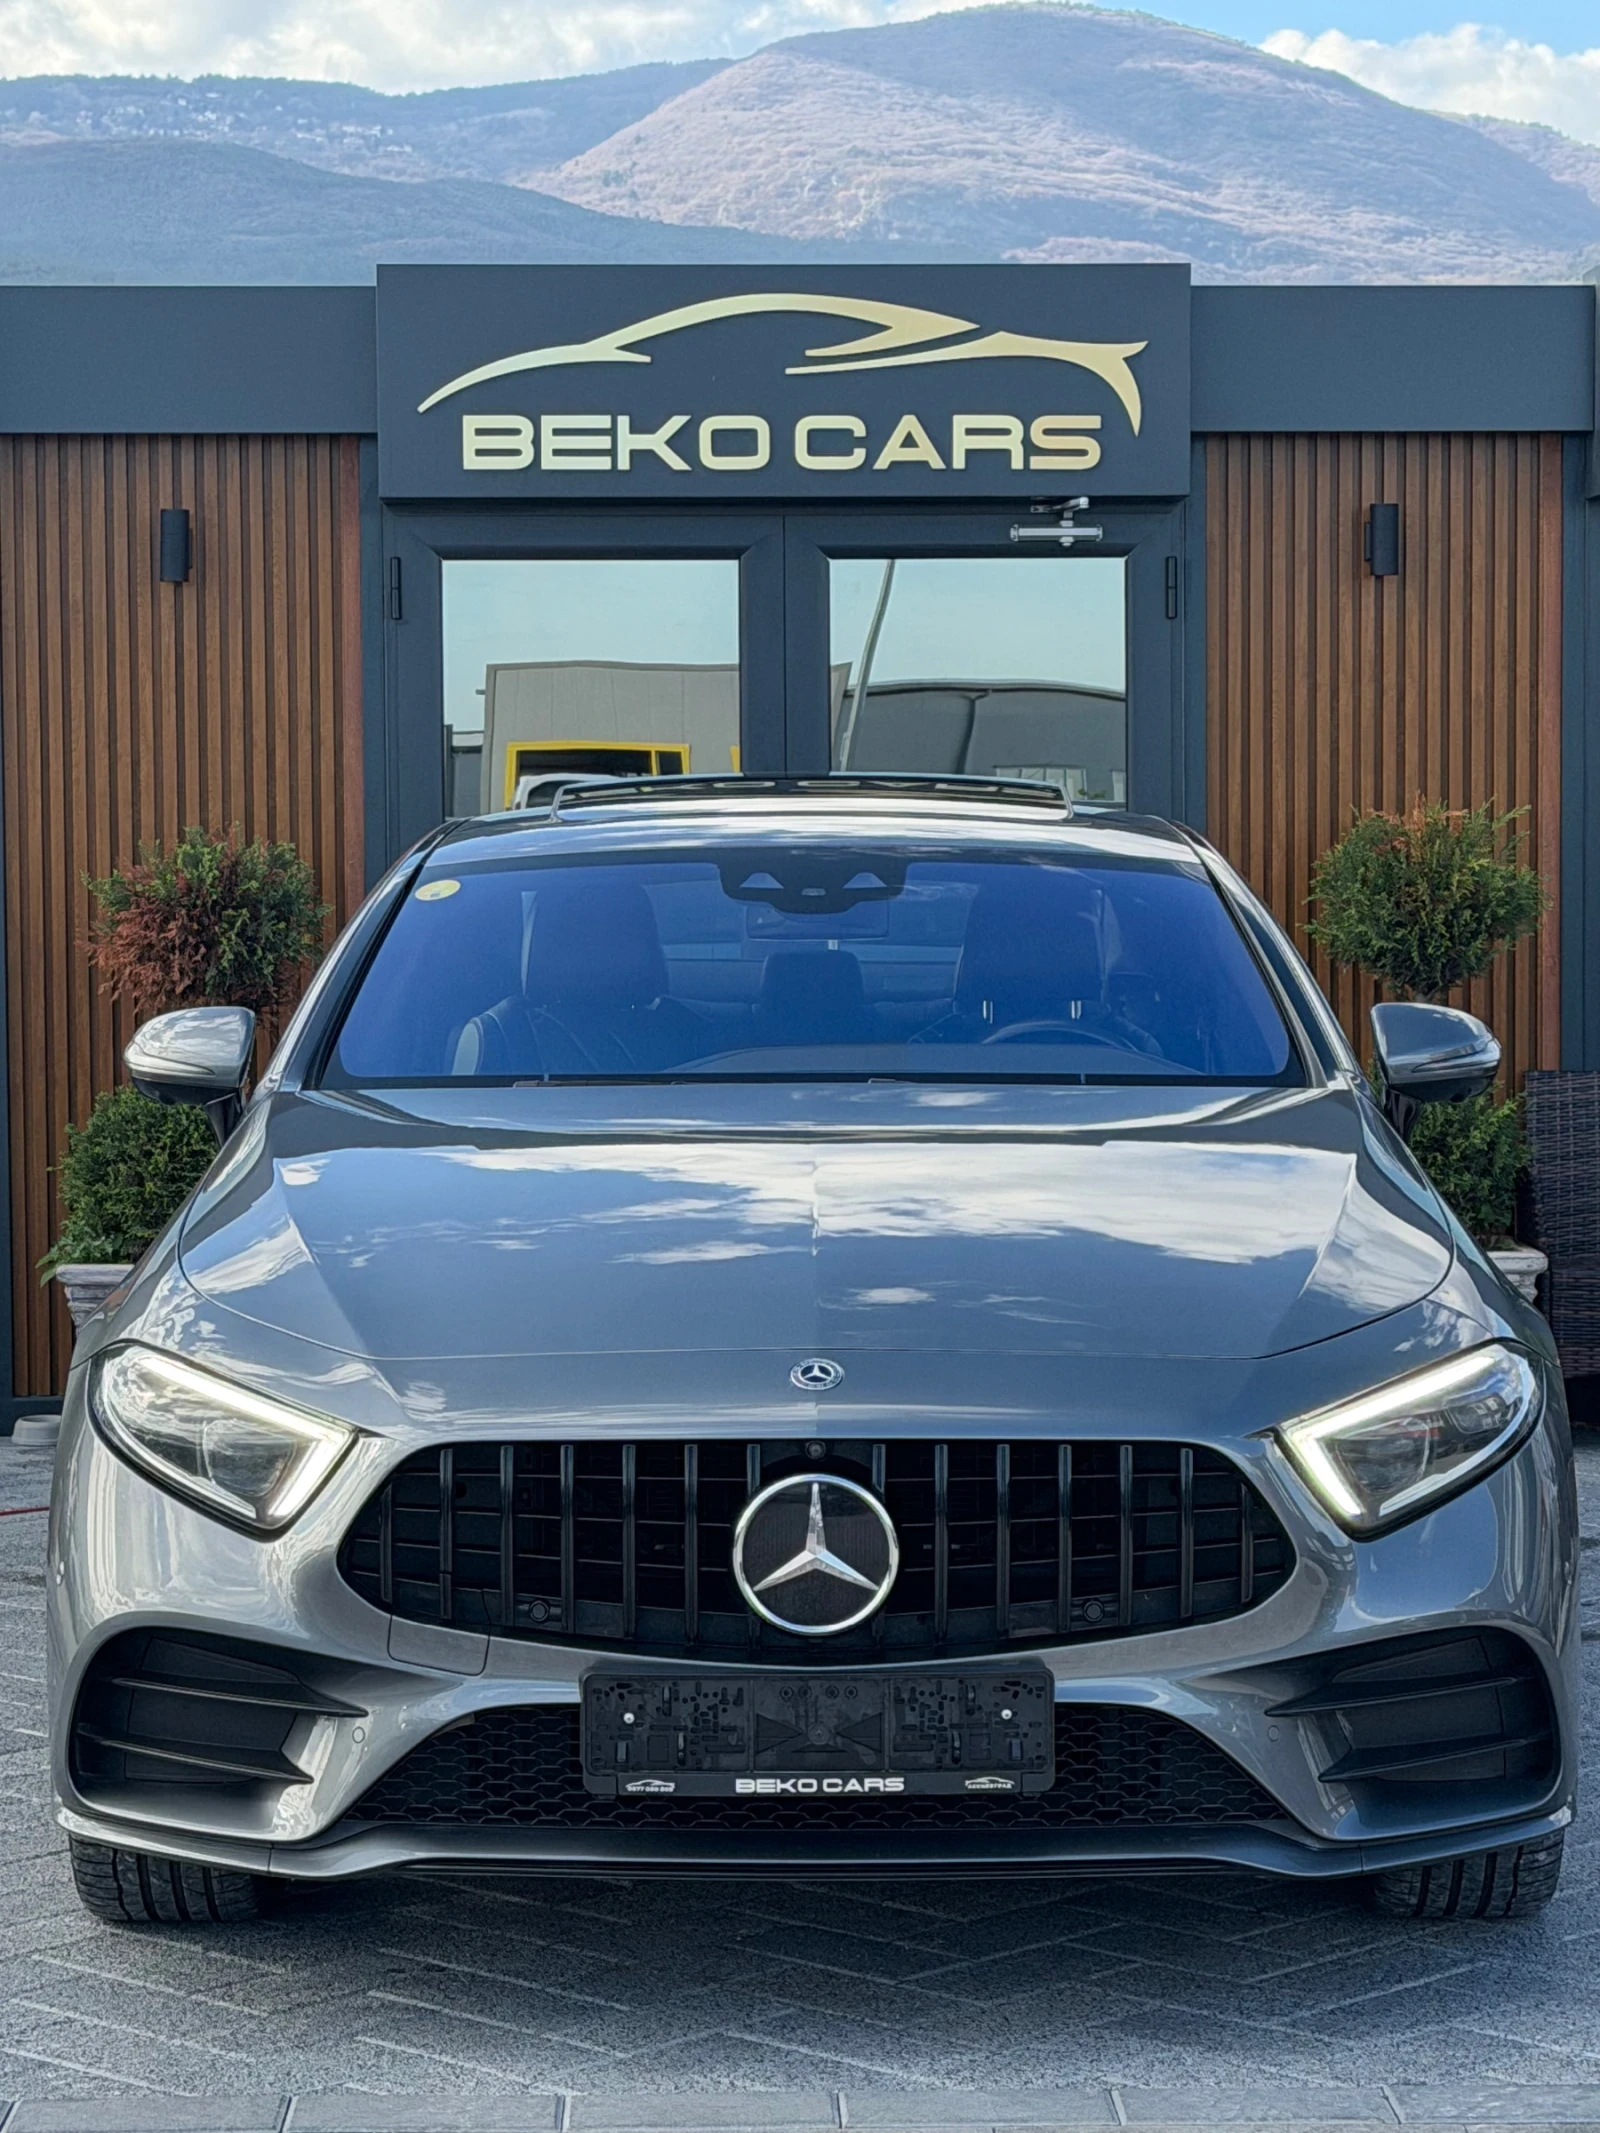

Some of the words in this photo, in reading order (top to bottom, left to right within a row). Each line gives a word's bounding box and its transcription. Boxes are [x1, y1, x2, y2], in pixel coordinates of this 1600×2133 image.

[462, 414, 771, 471] BEKO
[794, 414, 1103, 471] CARS
[735, 1777, 818, 1793] BEKO
[822, 1777, 905, 1793] CARS
